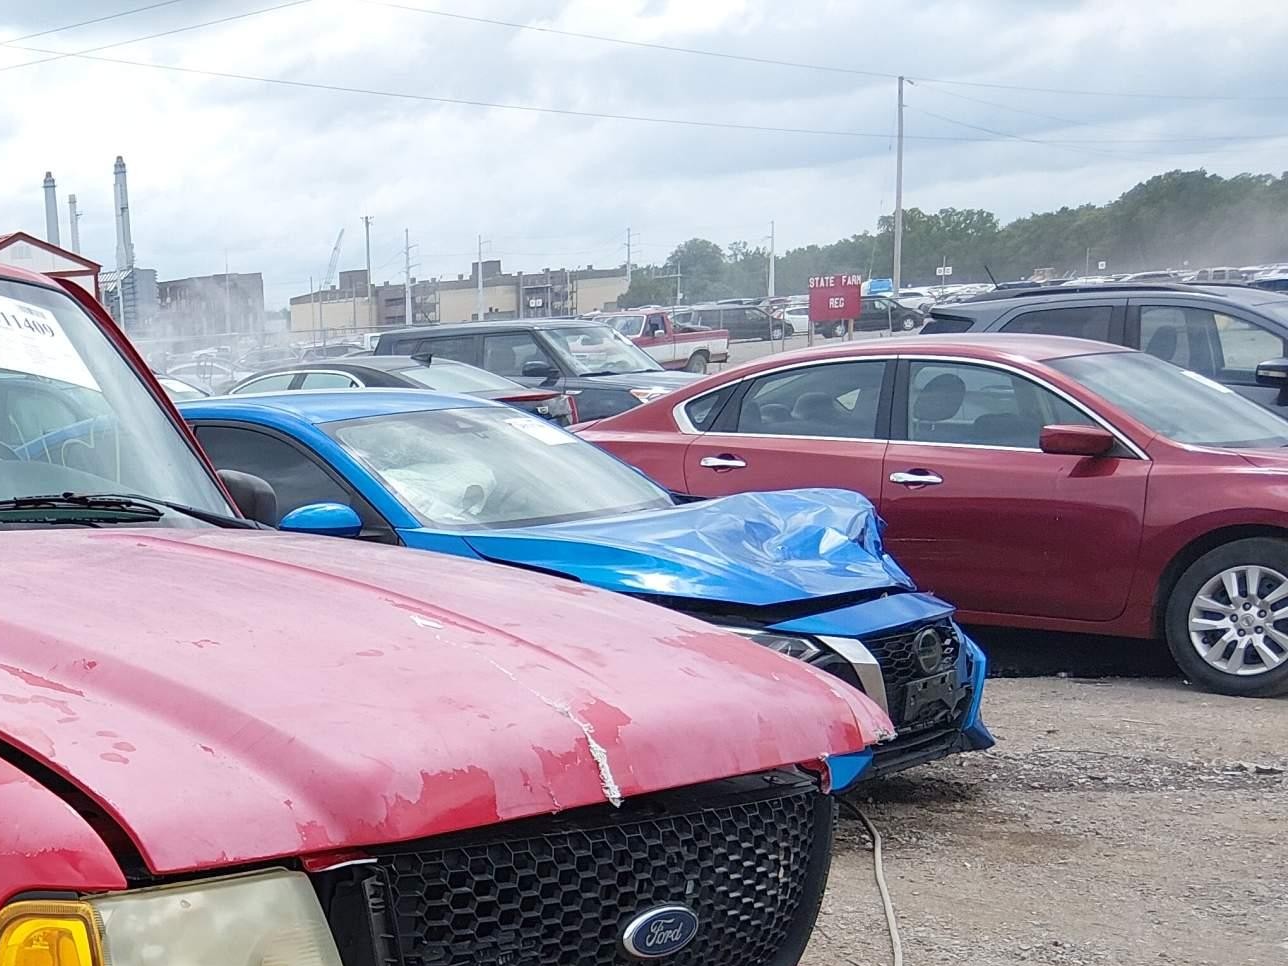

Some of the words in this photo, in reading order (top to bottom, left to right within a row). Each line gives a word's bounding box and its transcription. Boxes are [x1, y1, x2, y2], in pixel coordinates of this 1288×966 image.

[809, 276, 835, 288] STATE
[829, 298, 845, 309] REG
[645, 918, 684, 947] Ford
